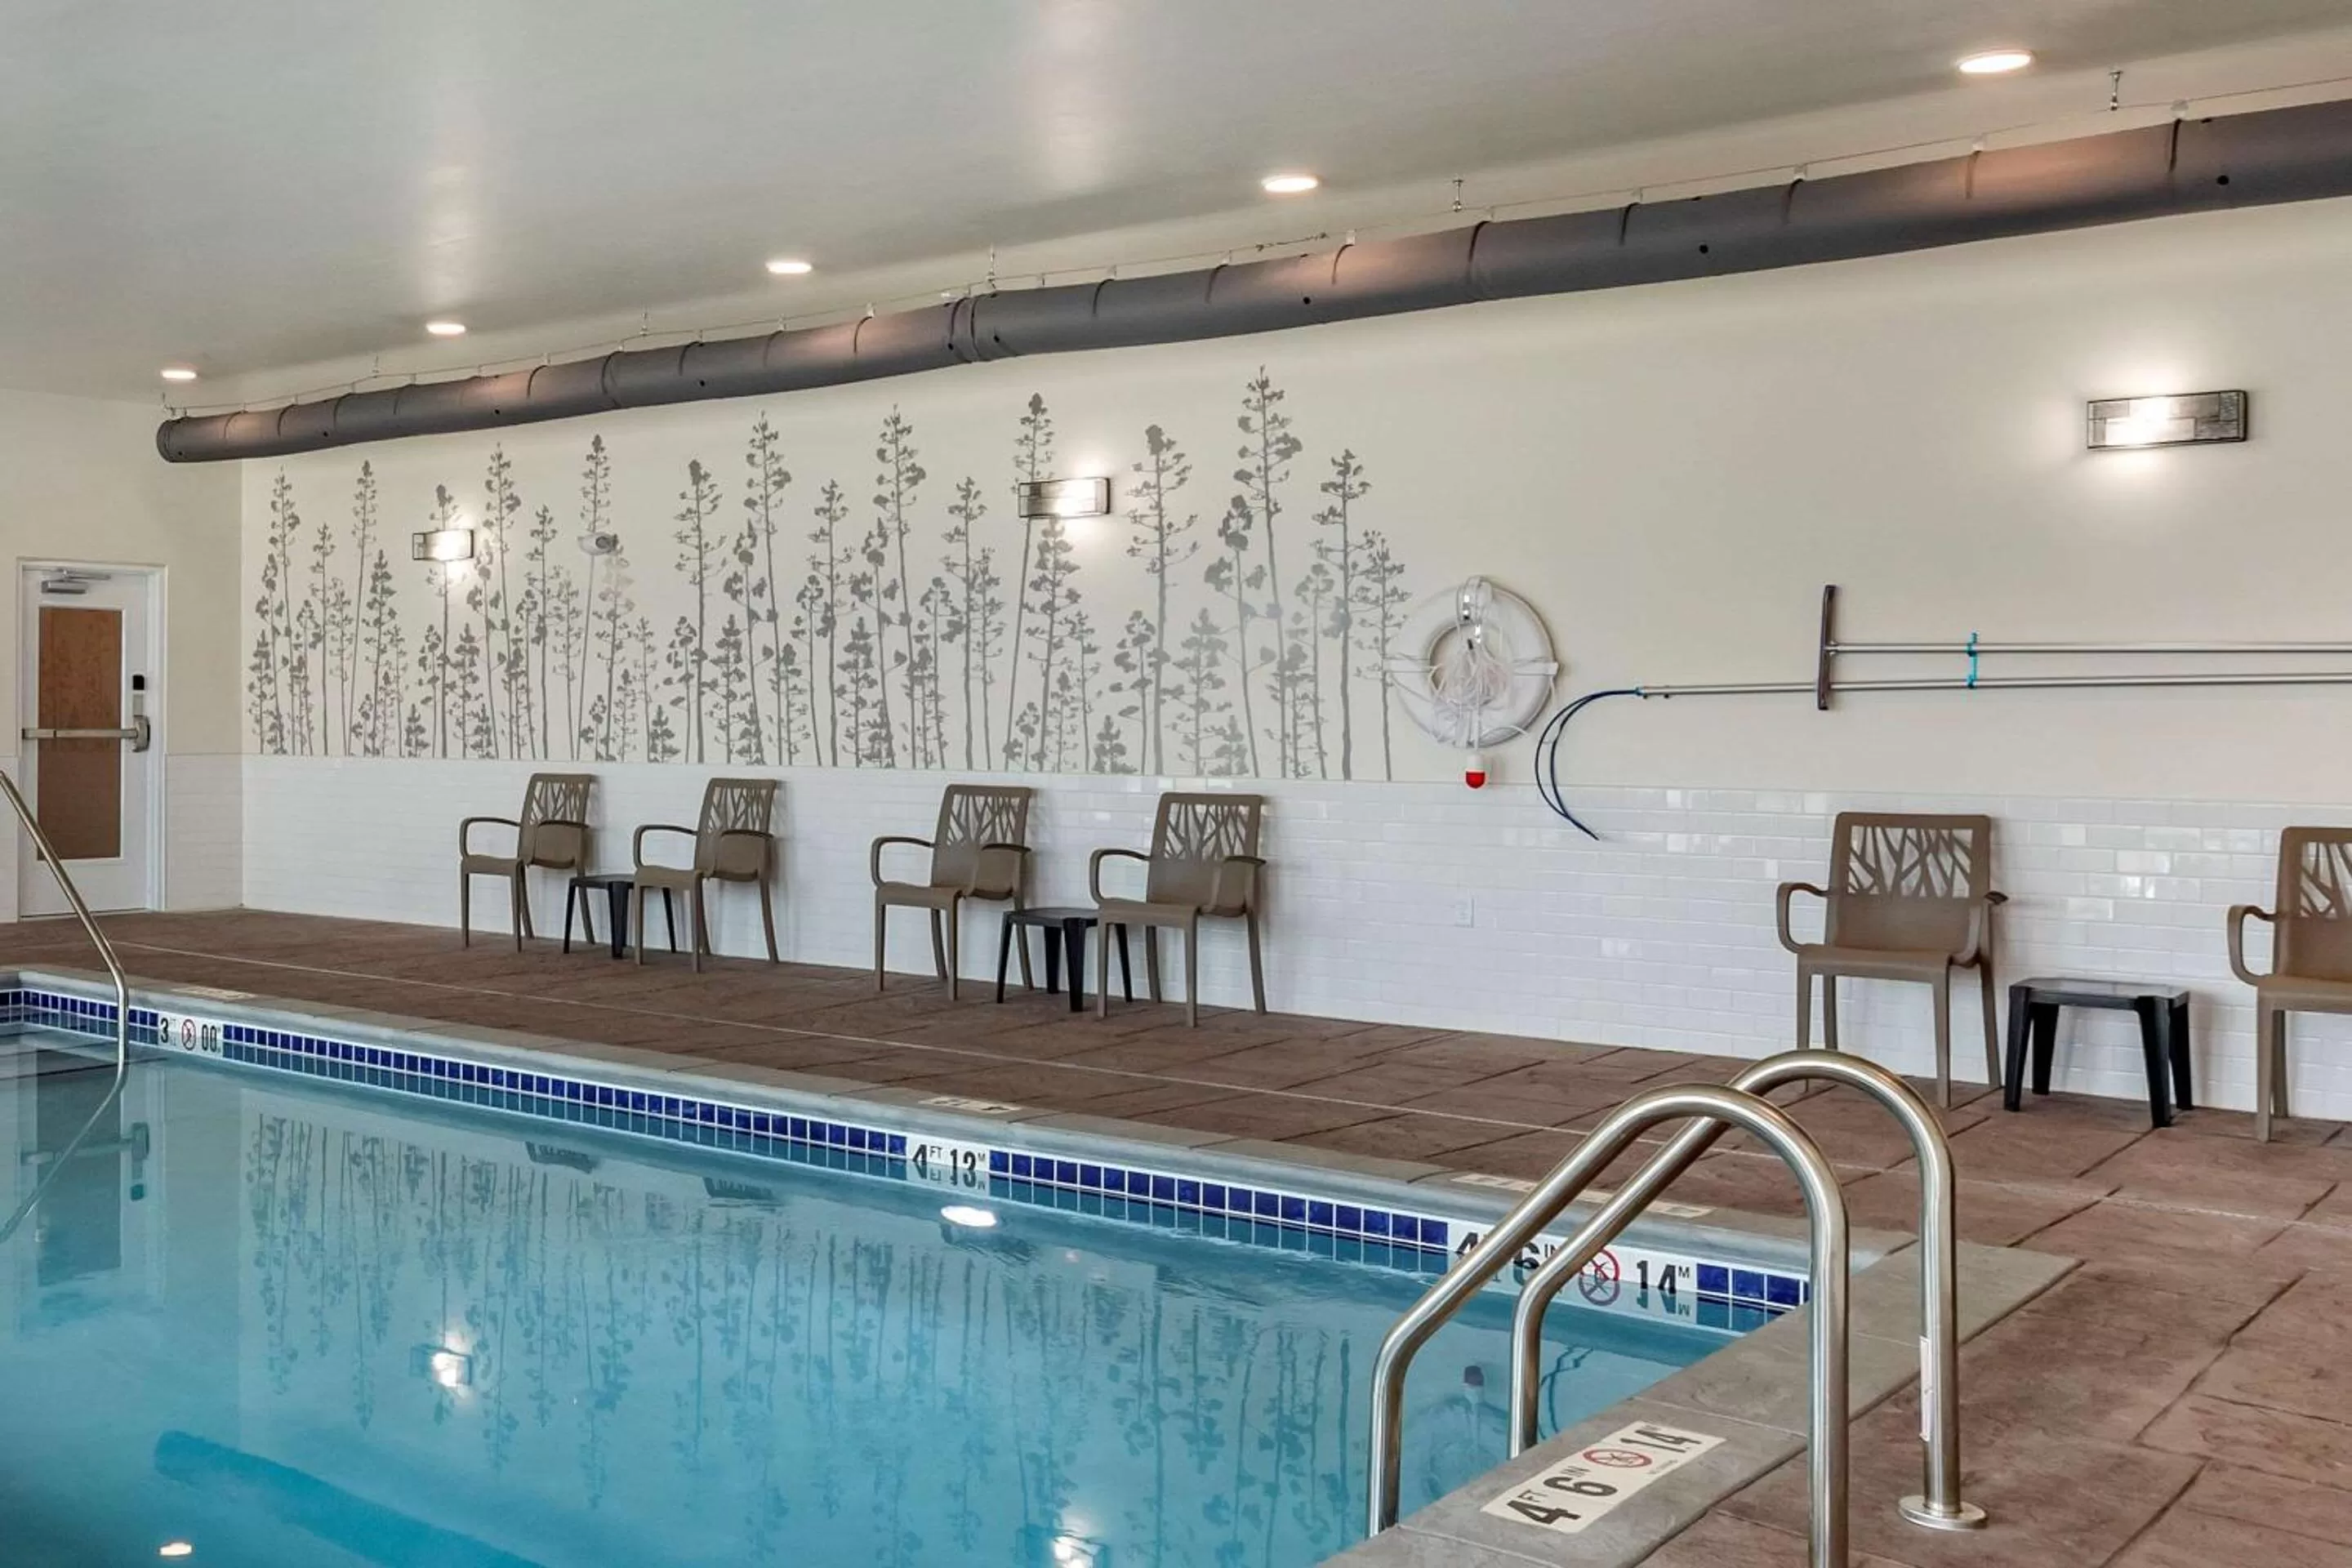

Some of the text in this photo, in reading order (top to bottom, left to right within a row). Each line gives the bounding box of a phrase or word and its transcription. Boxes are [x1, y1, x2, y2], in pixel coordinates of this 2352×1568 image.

[929, 1146, 942, 1159] FT
[1678, 1265, 1690, 1278] M
[1543, 1477, 1619, 1496] 6
[1517, 1489, 1551, 1504] FT
[1506, 1498, 1581, 1525] 4
